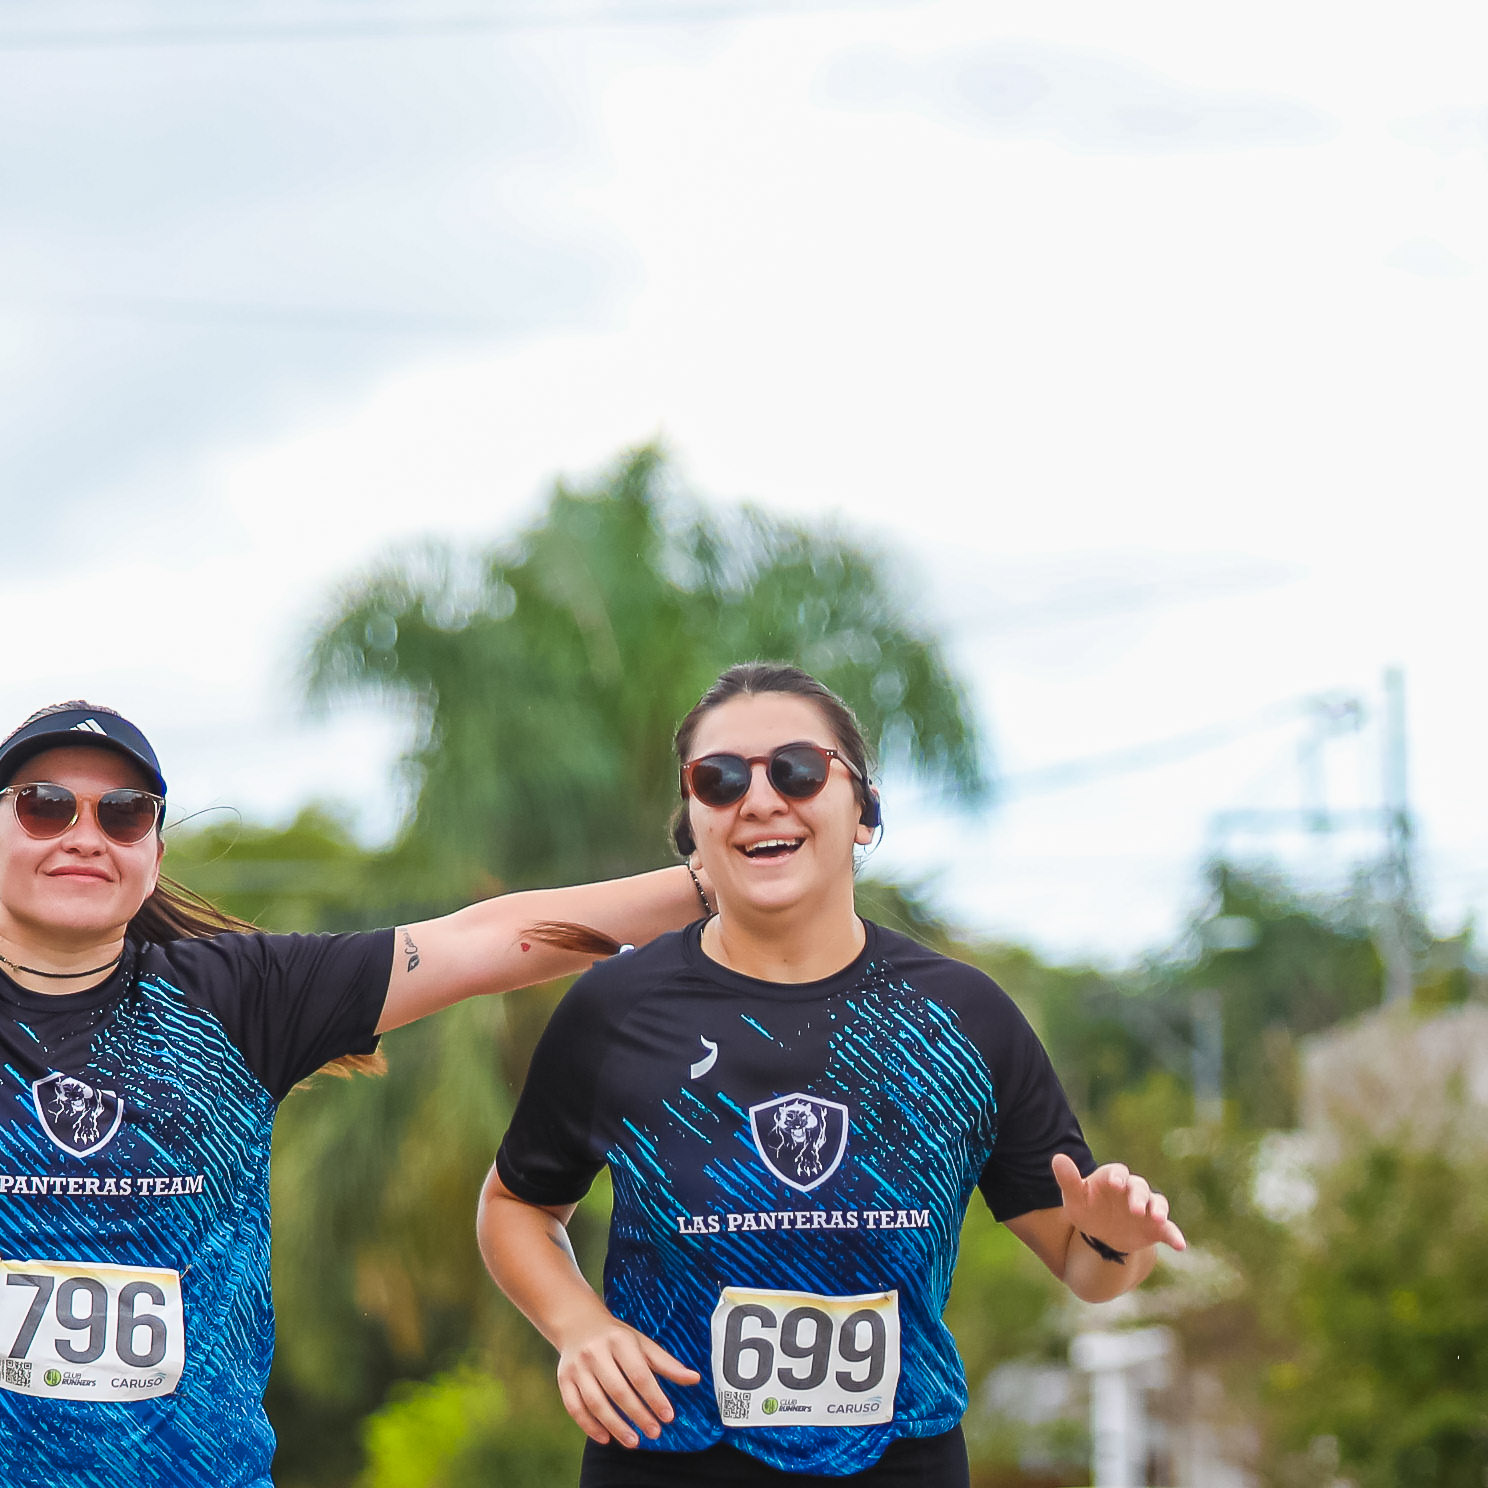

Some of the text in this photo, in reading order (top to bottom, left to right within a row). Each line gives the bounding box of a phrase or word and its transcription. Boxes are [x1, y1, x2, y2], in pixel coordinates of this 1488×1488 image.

[137, 1174, 204, 1196] TEAM
[677, 1209, 930, 1234] LAS PANTERAS TEAM
[6, 1272, 167, 1368] 796
[722, 1303, 887, 1393] 699
[111, 1377, 163, 1389] CARUSO
[826, 1402, 880, 1414] CARUSO
